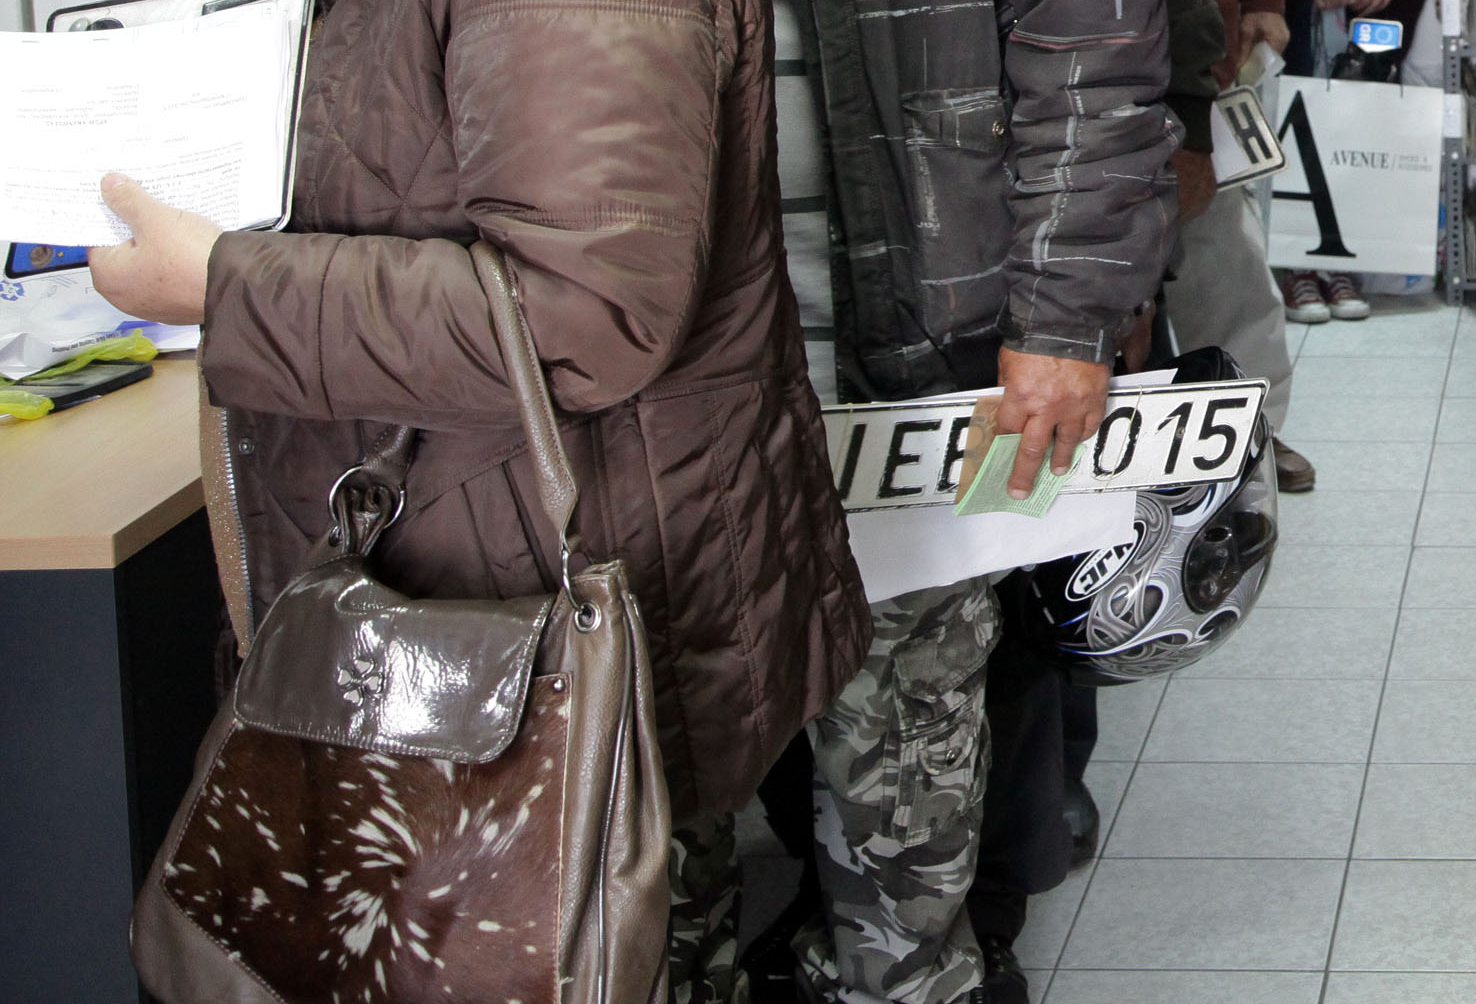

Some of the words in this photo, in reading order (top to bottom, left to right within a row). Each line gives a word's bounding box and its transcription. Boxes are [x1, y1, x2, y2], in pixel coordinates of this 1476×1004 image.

[1272, 90, 1357, 258] A
[1330, 149, 1390, 169] AVENUE
[1092, 397, 1249, 478] 015
